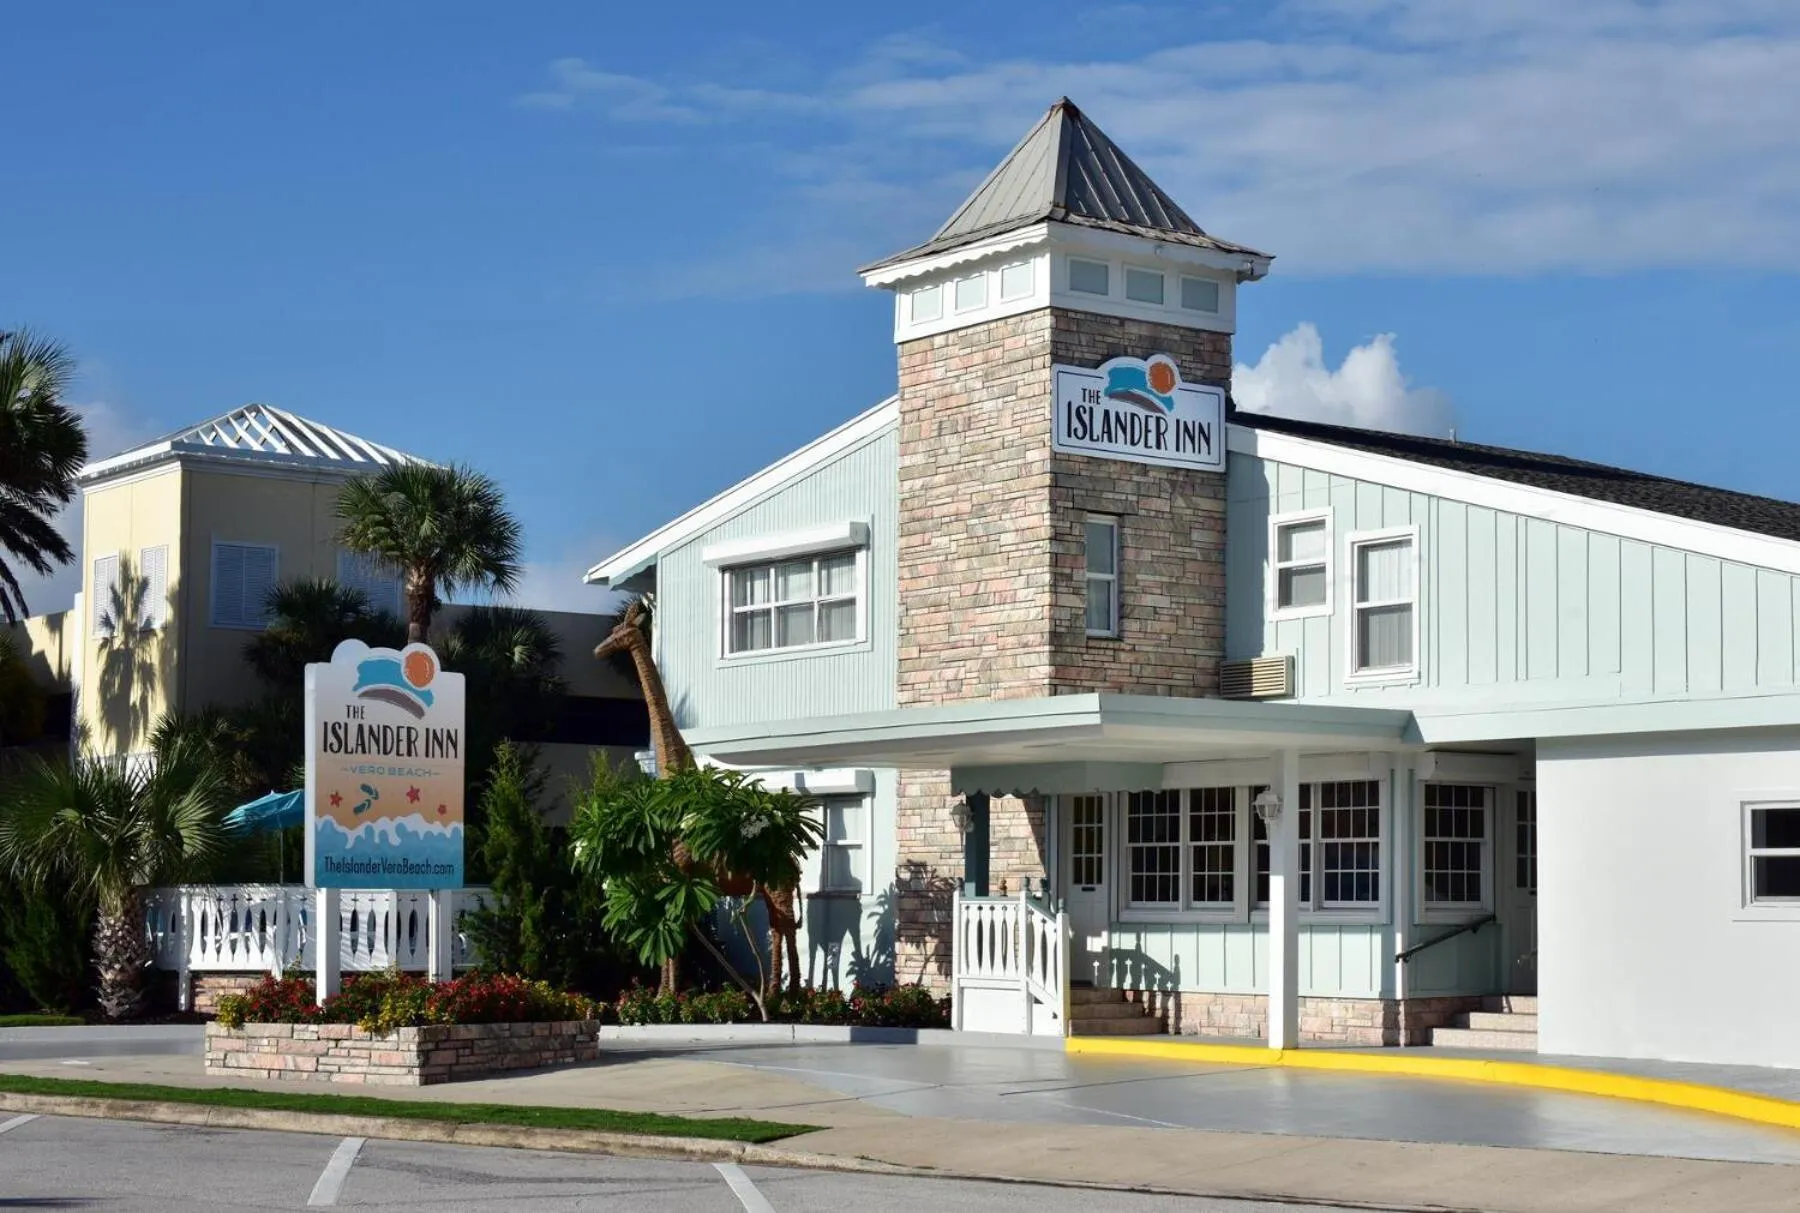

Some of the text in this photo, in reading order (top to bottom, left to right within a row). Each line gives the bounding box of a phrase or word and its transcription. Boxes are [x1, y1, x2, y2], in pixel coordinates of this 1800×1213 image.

[1081, 388, 1101, 405] THE
[1067, 401, 1211, 456] ISLANDER INN
[345, 704, 365, 720] THE
[323, 721, 458, 759] ISLANDER INN
[350, 765, 432, 777] VERO BEACH
[324, 856, 455, 876] TheIslanderVeroBeach.com
